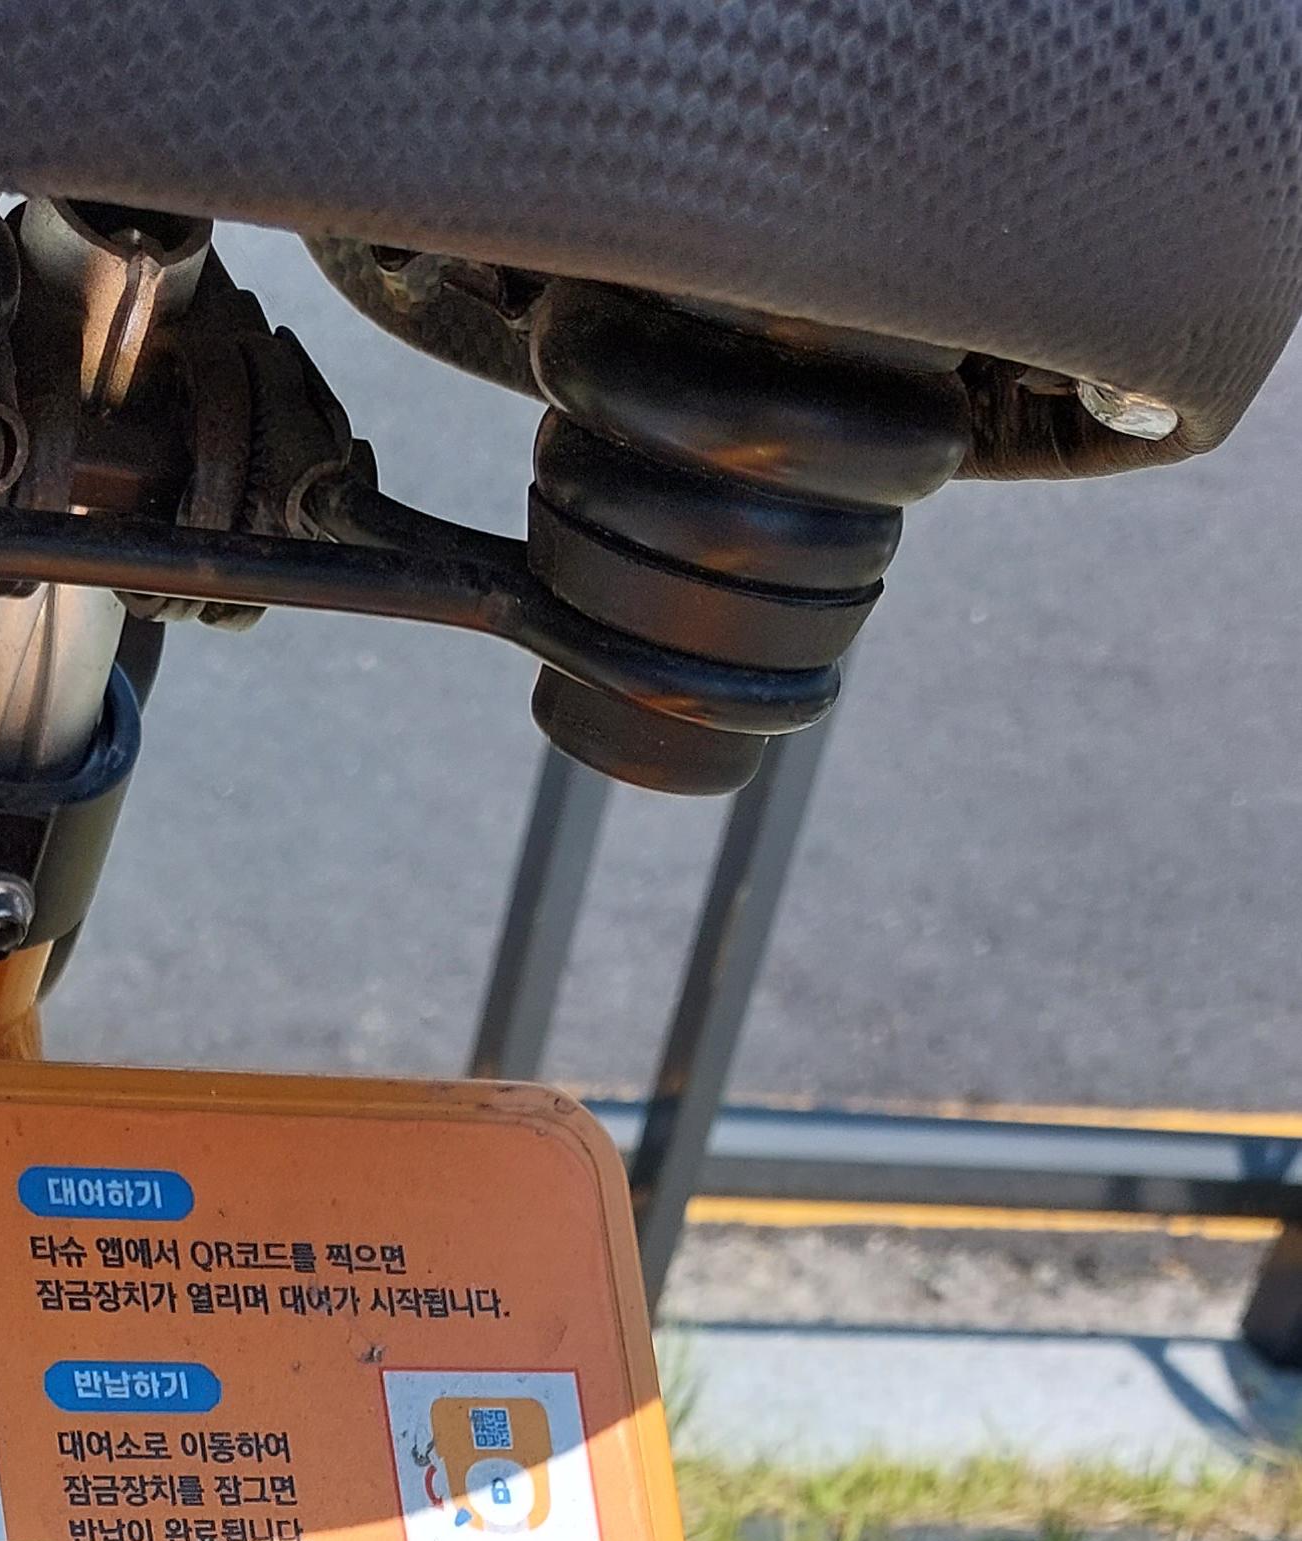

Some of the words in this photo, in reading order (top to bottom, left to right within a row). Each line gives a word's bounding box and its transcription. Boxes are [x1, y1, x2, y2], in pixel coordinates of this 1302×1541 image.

[48, 1177, 163, 1209] 대여하기
[29, 1235, 88, 1268] 타슈
[95, 1237, 181, 1270] 앱에서
[190, 1240, 317, 1273] QR코드를
[325, 1243, 407, 1275] 찍으면
[35, 1279, 178, 1314] 잠금장치가
[186, 1282, 270, 1316] 열리며
[278, 1284, 360, 1318] 대여가
[370, 1286, 510, 1319] 시작됩니다.
[73, 1369, 189, 1400] 반납하기
[57, 1430, 173, 1463] 대여소로
[180, 1430, 291, 1464] 이동하여
[63, 1474, 205, 1507] 잠금장치를
[214, 1474, 299, 1507] 잠그면
